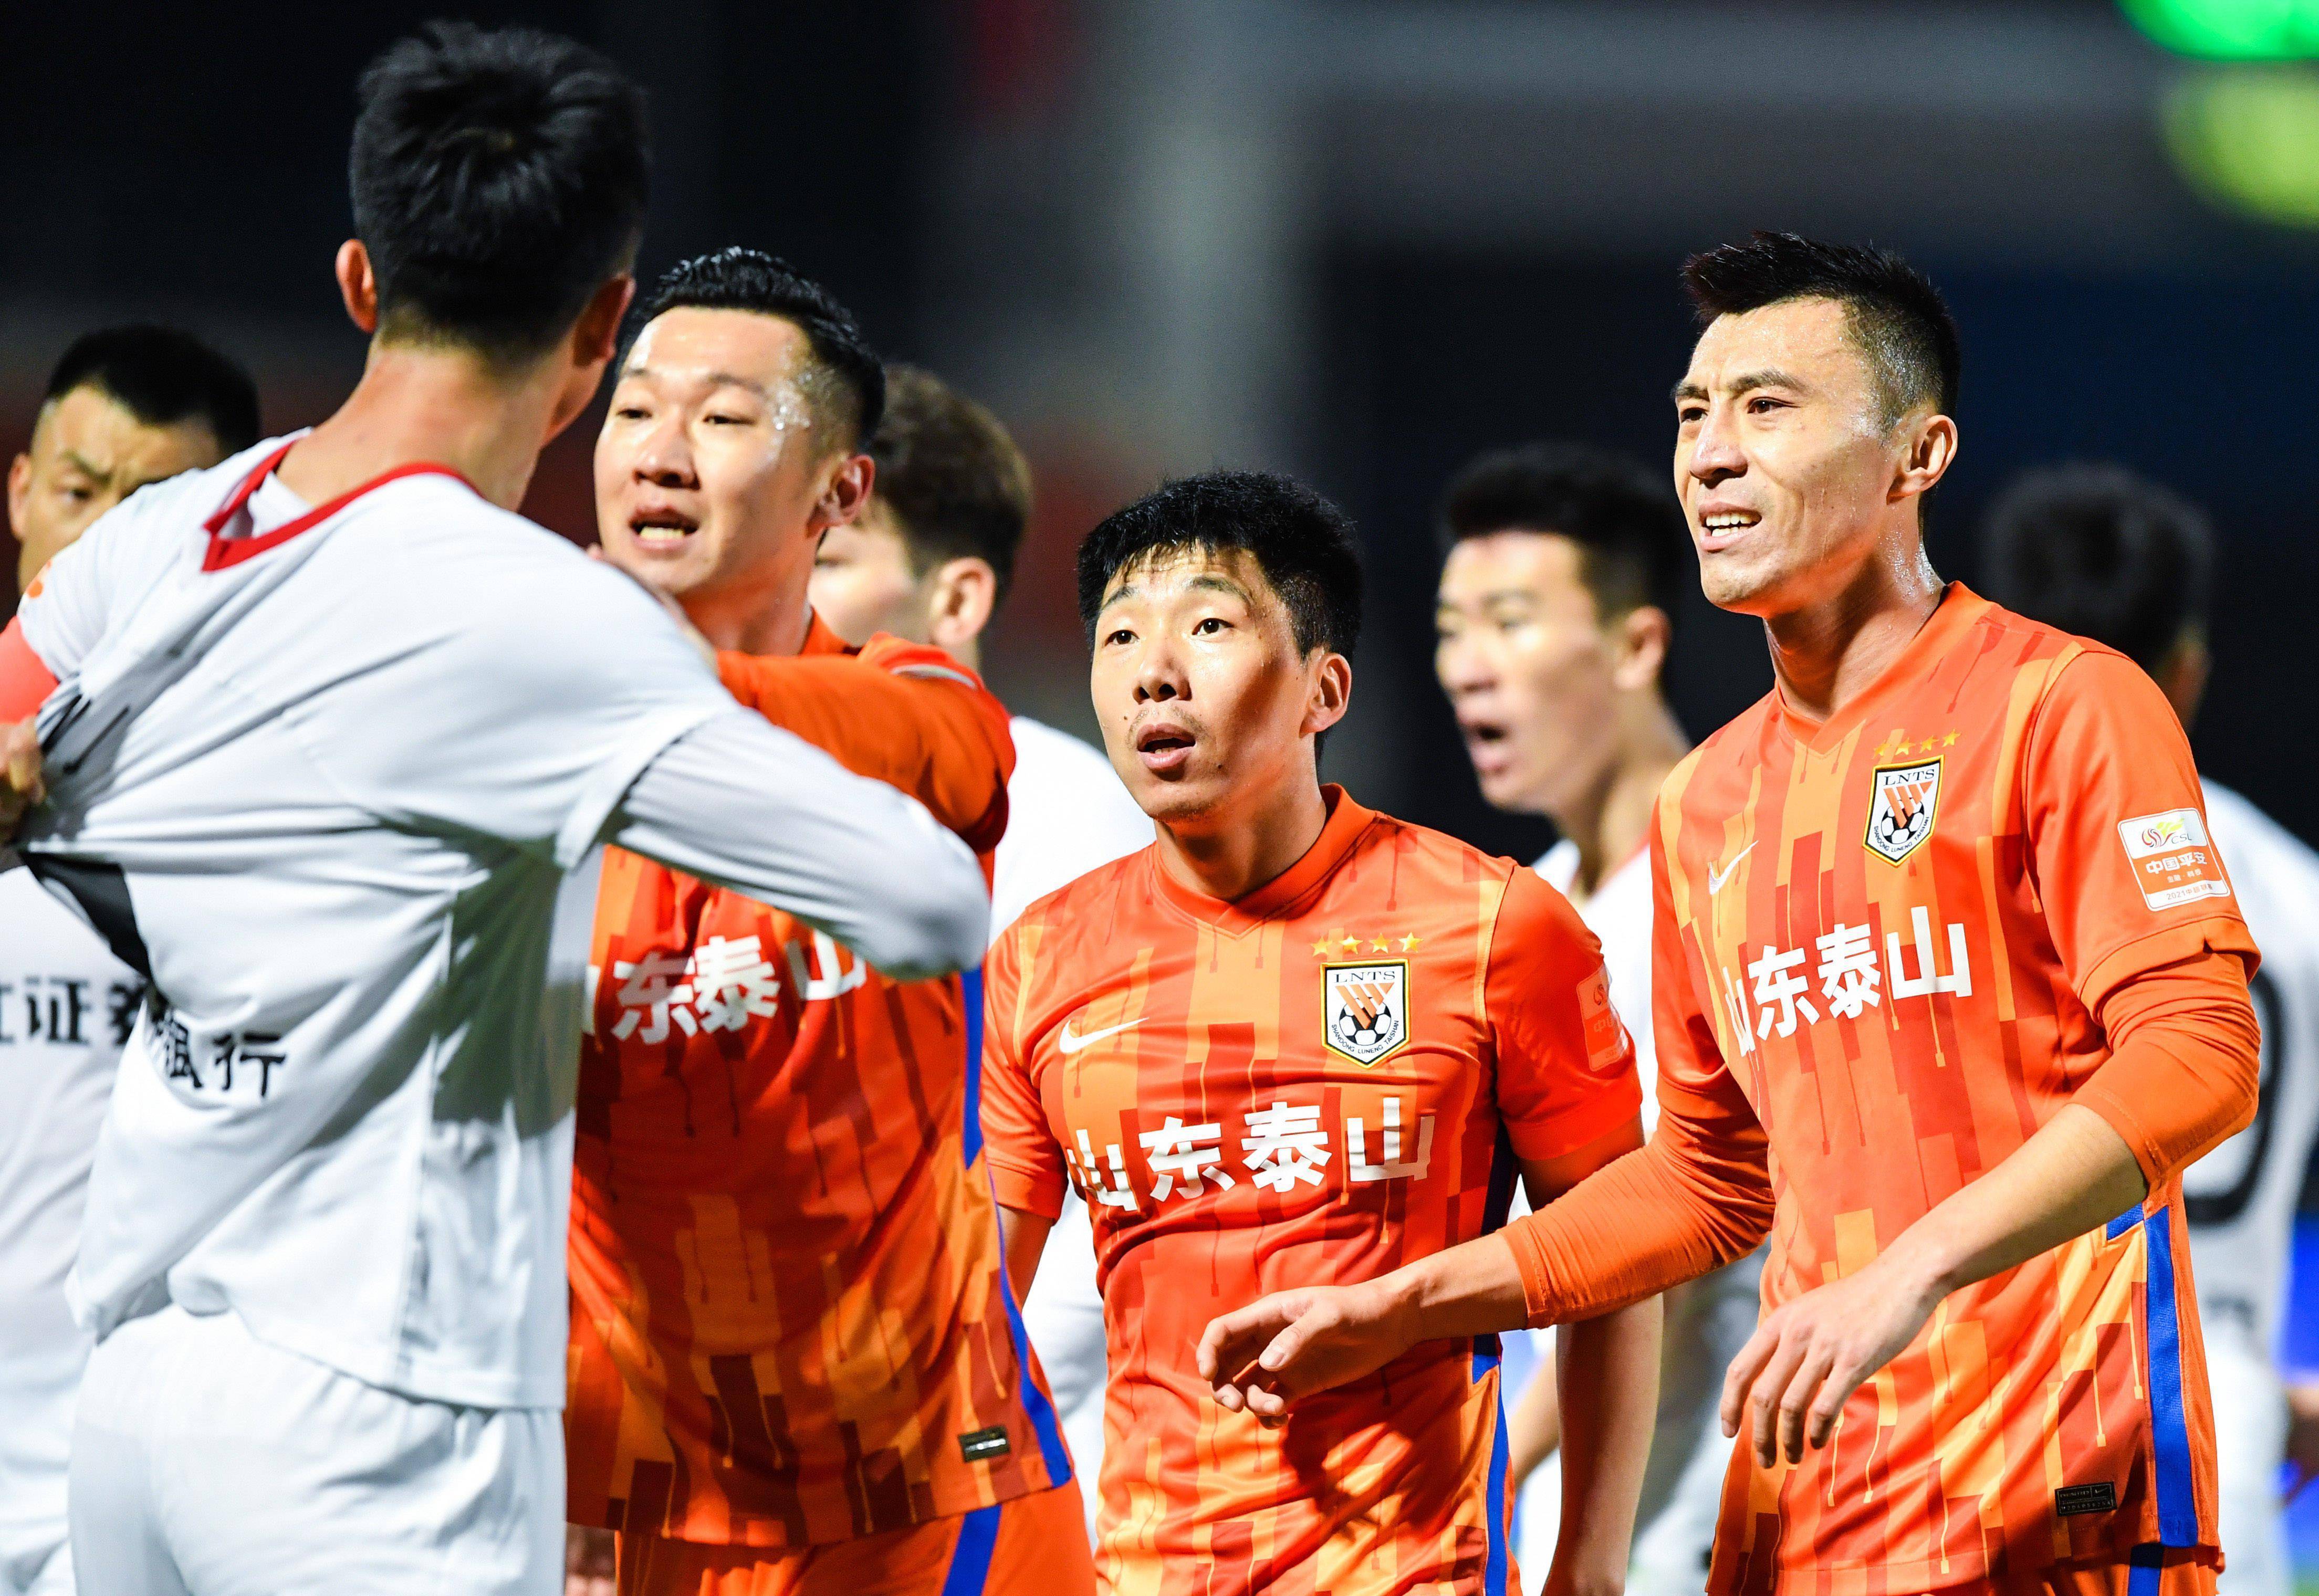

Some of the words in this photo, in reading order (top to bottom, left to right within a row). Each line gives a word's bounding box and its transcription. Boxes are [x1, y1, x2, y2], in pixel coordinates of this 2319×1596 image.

[1883, 769, 1935, 786] LNTS
[2171, 833, 2192, 844] CSL
[2145, 852, 2207, 874] 中国平安
[581, 930, 868, 1045] 东泰山
[1334, 971, 1395, 983] LNTS
[1722, 906, 1972, 1057] 山东泰山
[1332, 1024, 1355, 1052] SHANDONG
[1357, 1044, 1383, 1054] LUNENG
[1067, 1097, 1435, 1212] 山东泰山
